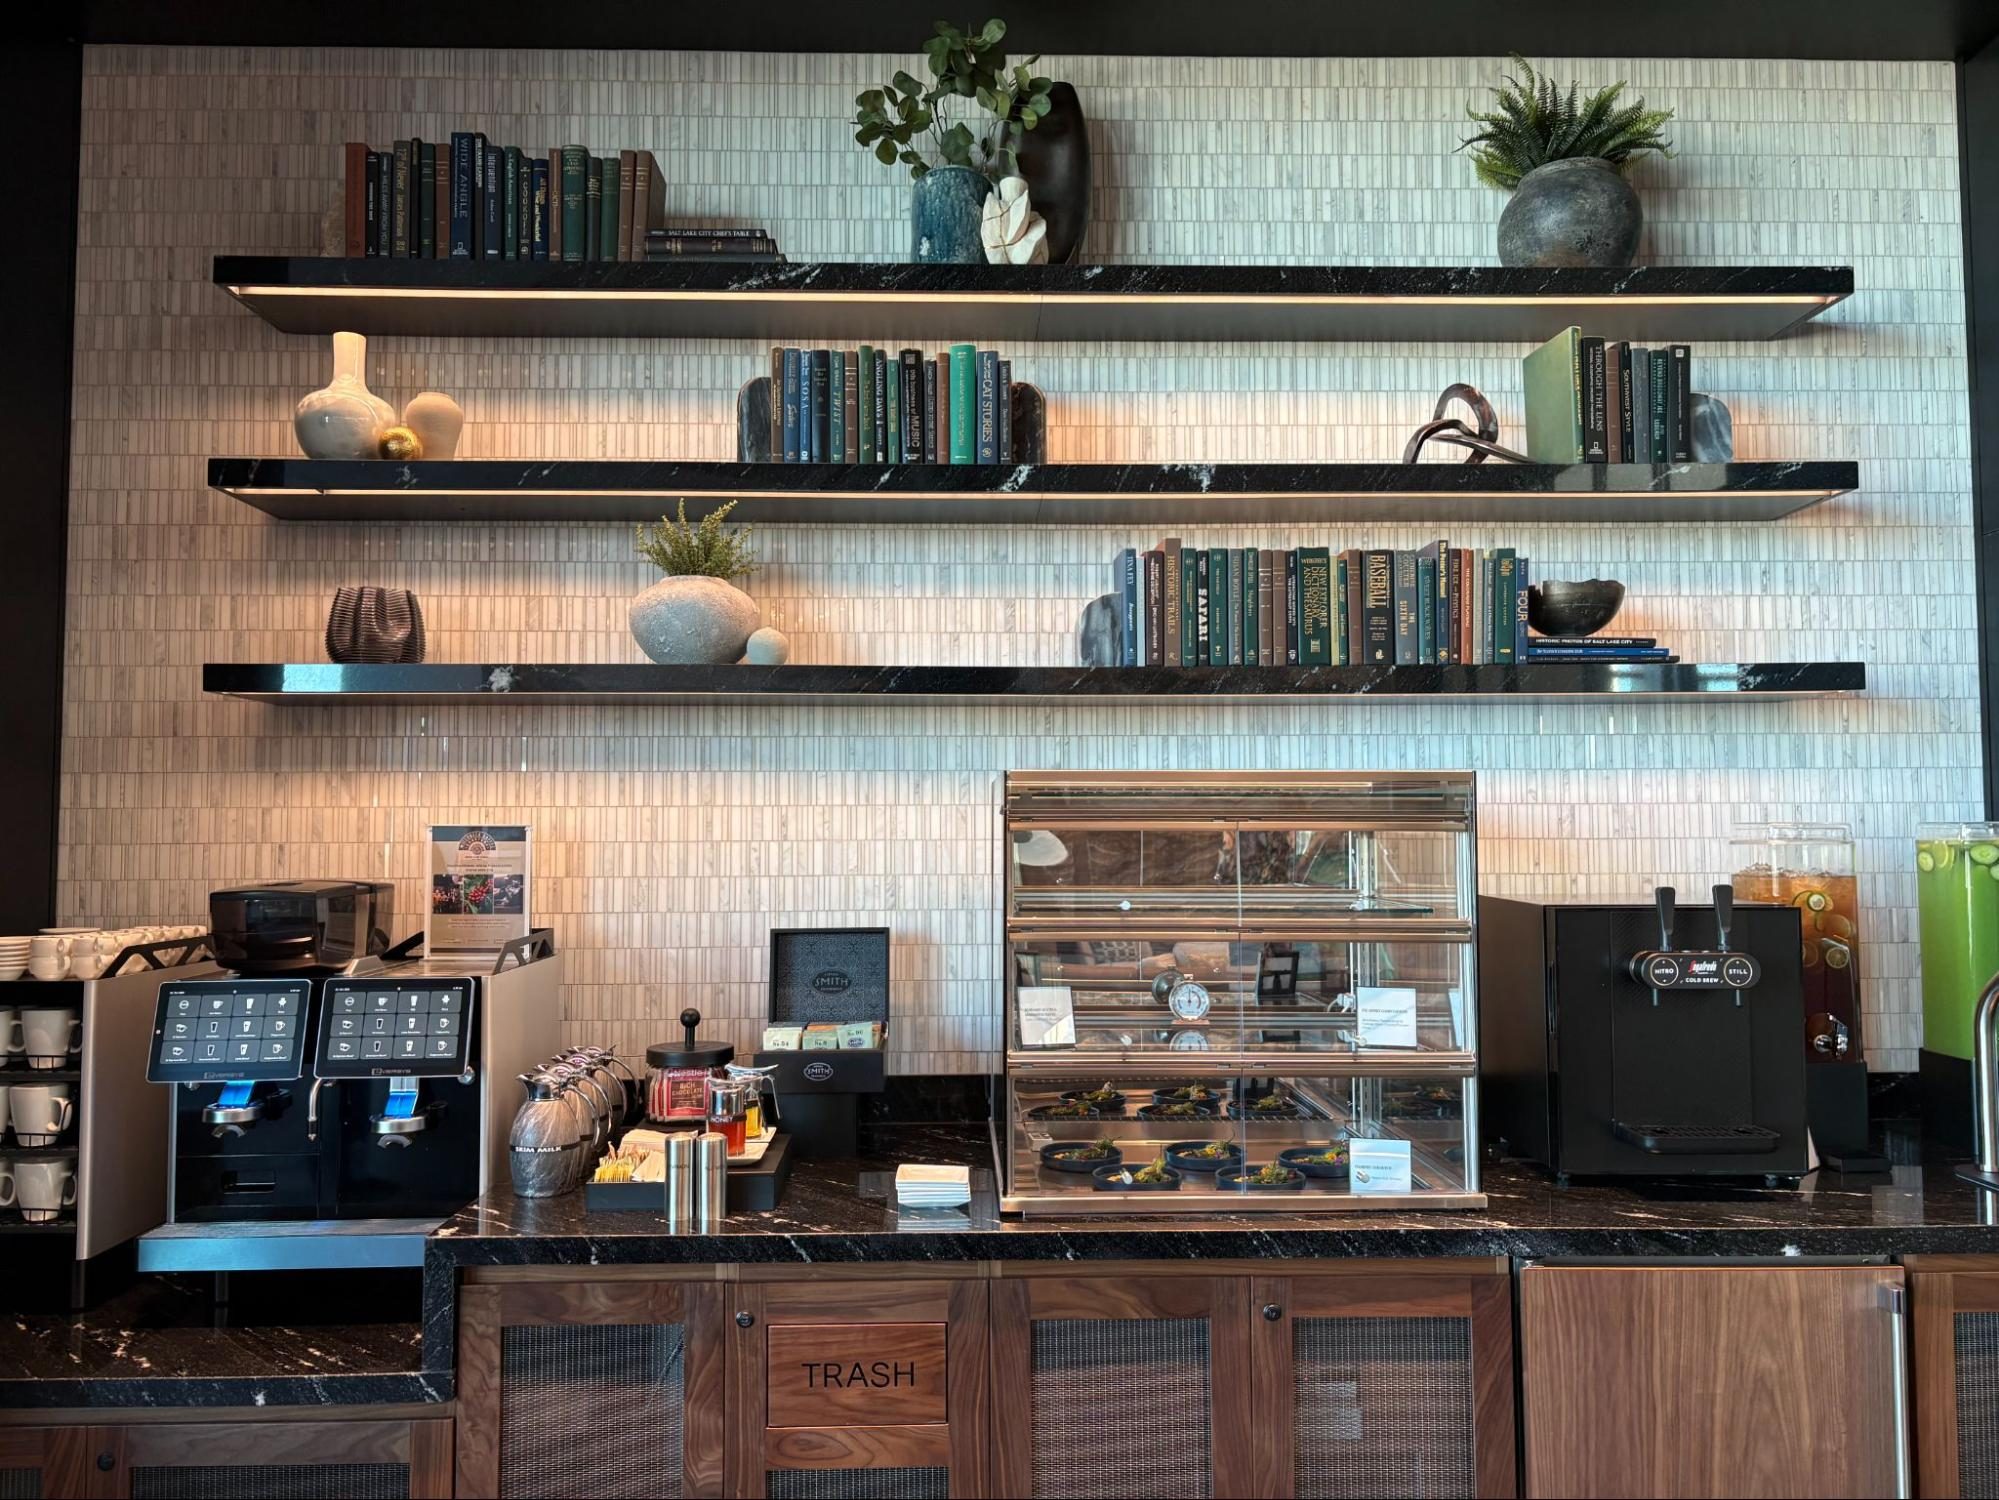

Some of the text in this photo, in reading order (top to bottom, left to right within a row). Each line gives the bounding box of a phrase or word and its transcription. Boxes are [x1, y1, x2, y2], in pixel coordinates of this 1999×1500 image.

[459, 137, 469, 219] WIDE ANGLE
[487, 153, 497, 194] Intervention
[875, 358, 883, 396] ANGLING
[1595, 345, 1603, 432] THROUGH THE LENS
[832, 391, 841, 425] TWIST
[875, 397, 883, 418] DAYS
[982, 379, 993, 442] CAT STORIES
[1623, 369, 1631, 433] SOUTHWEST STYLE
[911, 415, 920, 448] MUSIC
[1439, 541, 1447, 553] The
[1166, 555, 1175, 635] HISTORIC TRAILS
[1311, 566, 1320, 619] DICTIONARY
[1319, 566, 1328, 628] NEW EXPLORER
[1369, 554, 1387, 608] BASEBALL
[1198, 588, 1208, 642] SAFARI
[1303, 566, 1312, 636] AND THESAURUS
[1399, 600, 1408, 636] SIXTH DAY
[1516, 590, 1528, 622] FOUR
[814, 977, 849, 987] SMITH
[672, 1088, 703, 1096] CHOCOLATE
[679, 1081, 695, 1089] RICH
[537, 1145, 562, 1153] MILK
[801, 1361, 915, 1388] TRASH
